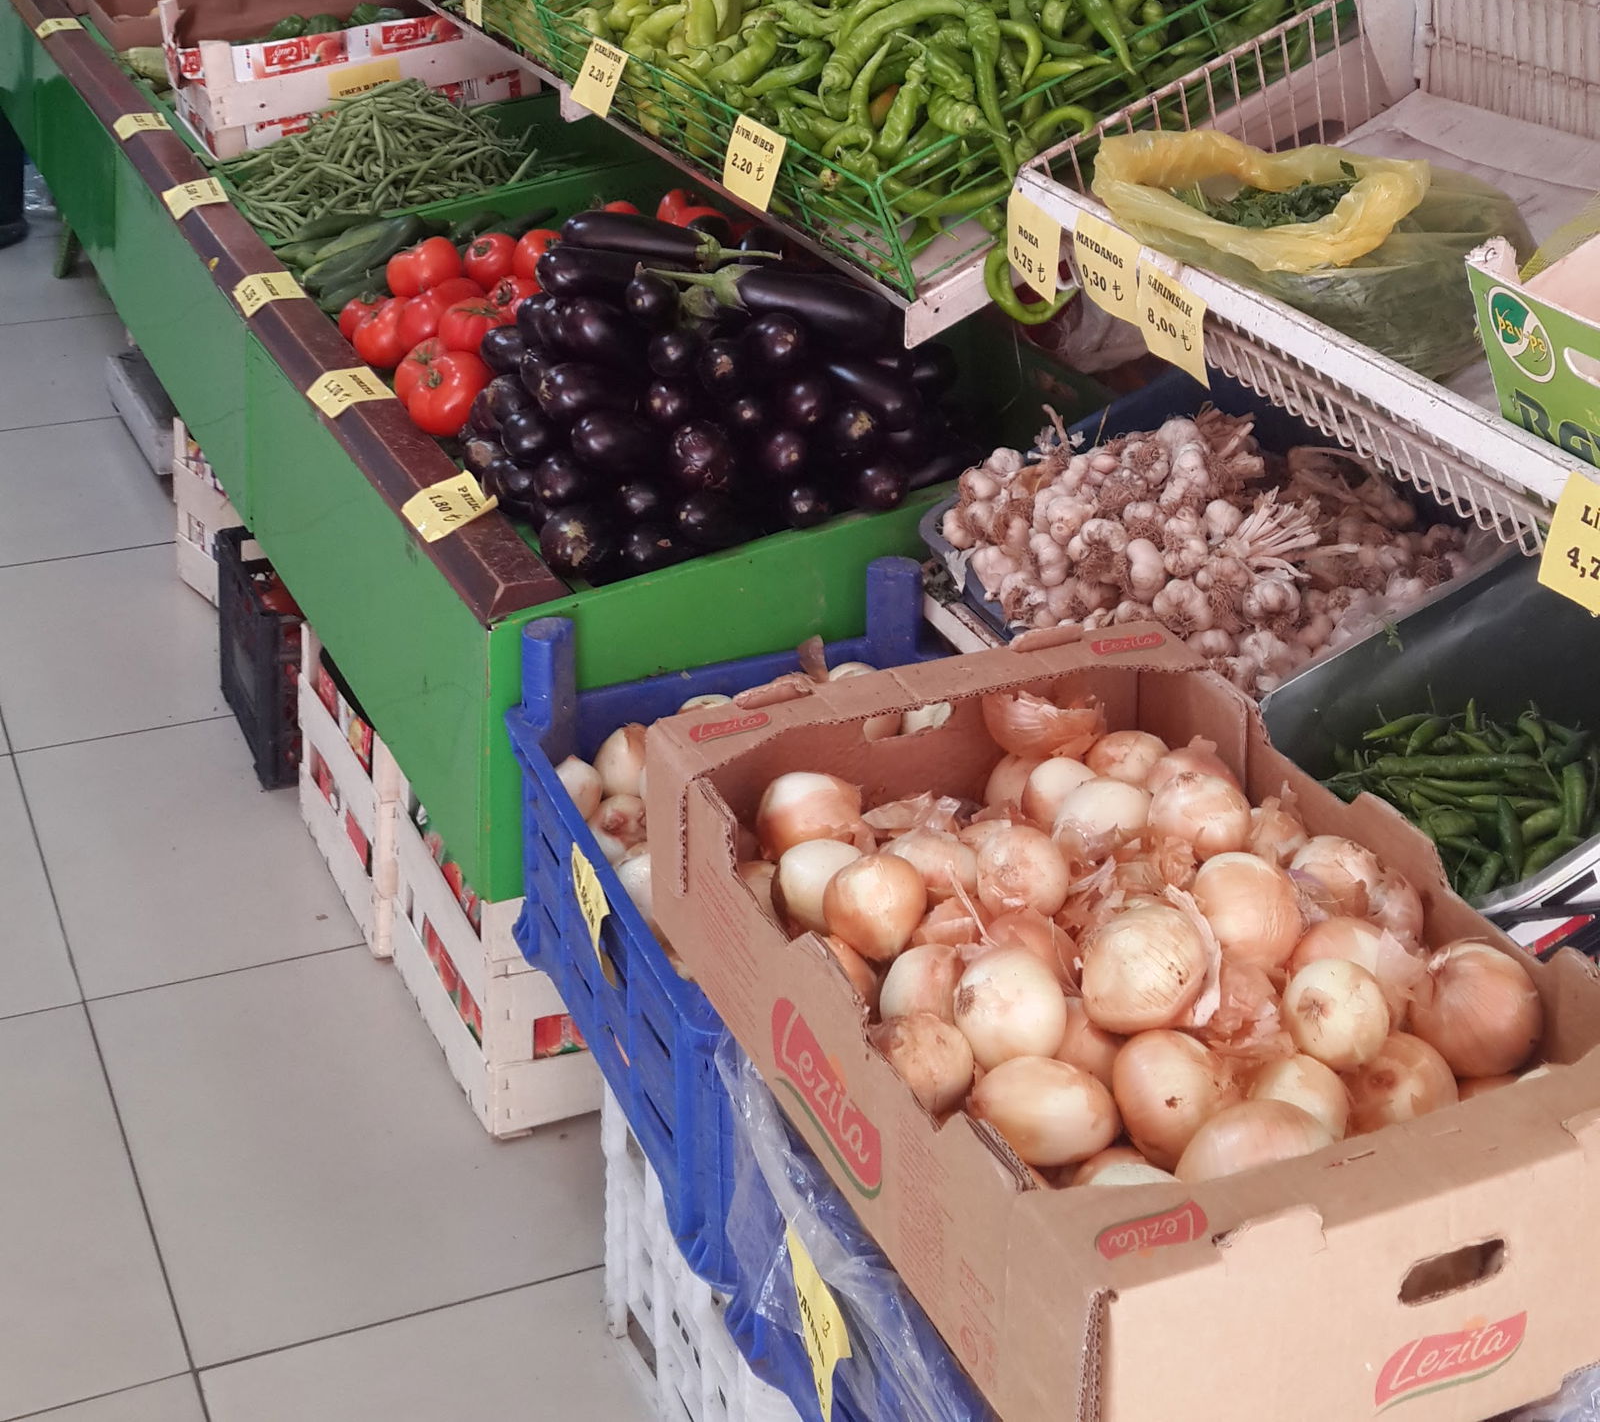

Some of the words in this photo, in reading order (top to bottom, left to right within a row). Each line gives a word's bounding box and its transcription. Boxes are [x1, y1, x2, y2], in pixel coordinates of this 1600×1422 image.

[731, 153, 753, 175] 2.20
[1018, 225, 1040, 249] ROKA
[1075, 230, 1125, 270] MAYDANOS
[1013, 245, 1034, 274] 0.75
[1082, 263, 1108, 292] 0,30
[1148, 273, 1194, 319] SARIMSAK
[1147, 307, 1178, 339] 8,00
[428, 494, 453, 512] 1.80
[781, 1007, 870, 1165] Lezita
[1108, 1209, 1195, 1253] Lezita
[1389, 1323, 1512, 1391] Lezita
